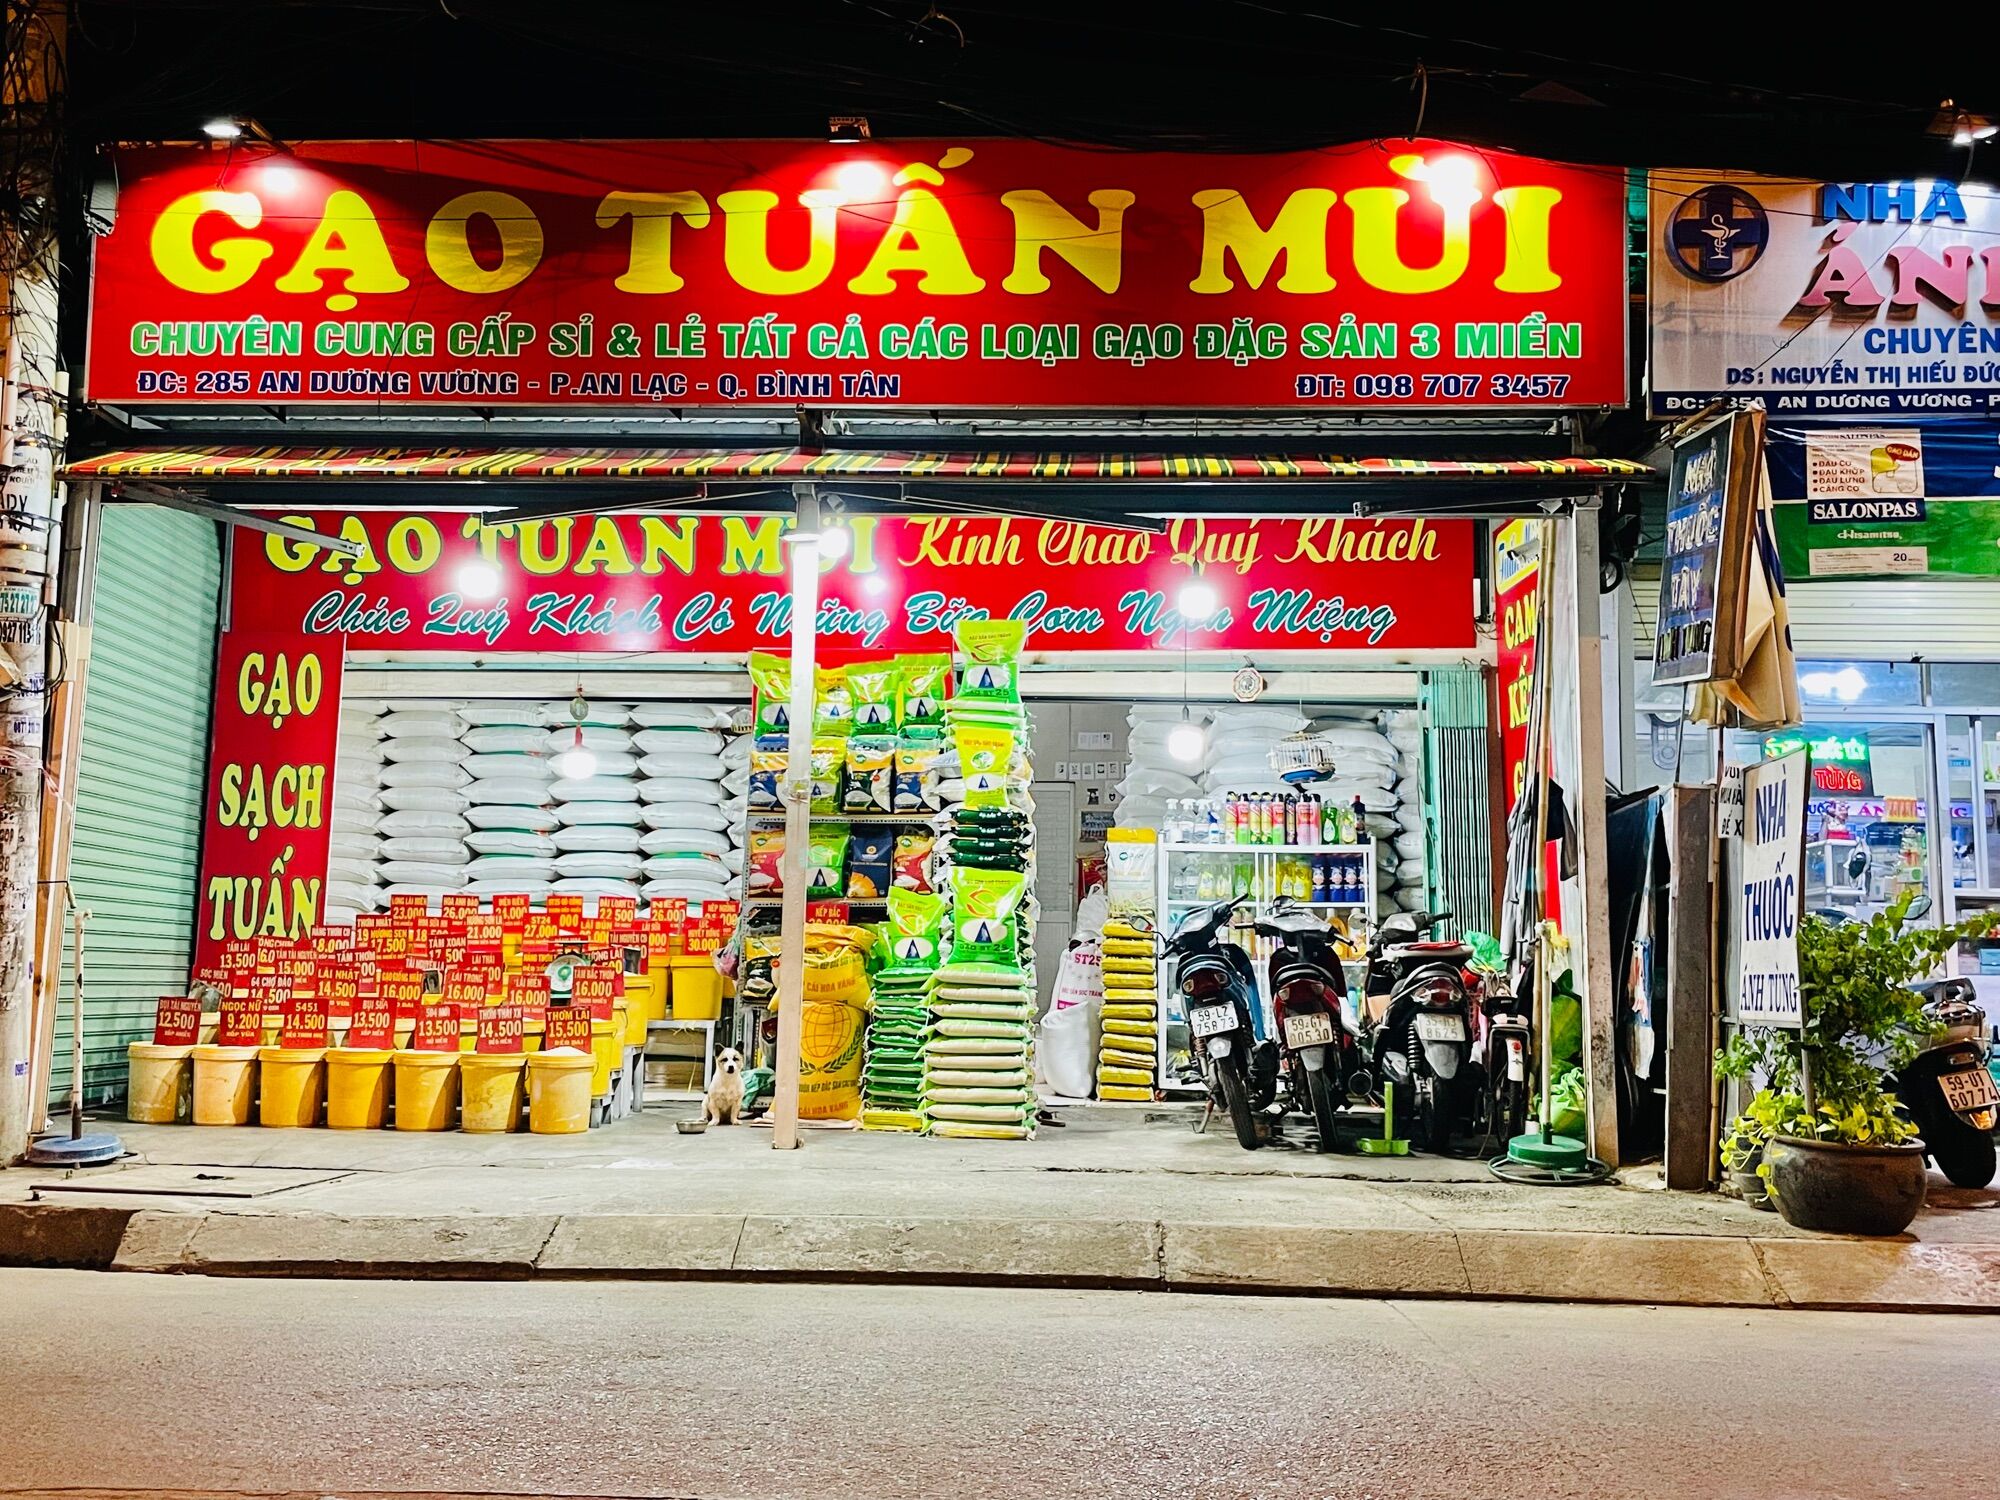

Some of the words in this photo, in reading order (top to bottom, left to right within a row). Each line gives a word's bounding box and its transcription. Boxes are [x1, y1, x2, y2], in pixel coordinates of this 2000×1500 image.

[150, 189, 545, 312] GẠO
[595, 146, 1137, 296] TUẤN
[1799, 222, 2000, 307] ÁN
[130, 315, 302, 359] CHUYÊN
[315, 322, 440, 359] CUNG
[448, 312, 535, 359] CẤP
[547, 313, 594, 359] SỈ
[607, 325, 644, 358] &
[654, 314, 706, 359] LẺ
[721, 312, 797, 359] TẤT
[808, 313, 870, 359] CẢ
[880, 316, 967, 359] CÁC
[981, 323, 1080, 367] LOẠI
[1095, 323, 1183, 367] GẠO
[1194, 319, 1287, 367] ĐẶC
[1301, 314, 1398, 359] SẢN
[1411, 323, 1439, 359] 3
[1456, 312, 1583, 359] MIỀN
[1771, 360, 1859, 385] NGUYỄN
[1865, 366, 1901, 388] THỊ
[1907, 360, 1956, 384] HIẾU
[136, 371, 188, 394] ĐC:
[195, 371, 250, 393] 285
[257, 371, 301, 394] AN
[309, 370, 411, 395] DƯƠNG
[419, 370, 519, 395] VƯƠNG
[548, 372, 620, 395] P.AN
[631, 372, 689, 400] LẠC
[718, 373, 747, 397] Q.
[756, 366, 831, 397] BÌNH
[838, 366, 901, 398] TÂN
[1295, 375, 1346, 398] ĐT:
[1352, 375, 1415, 398] 098
[1421, 375, 1483, 398] 707
[1490, 375, 1571, 398] 3457
[1666, 397, 1705, 410] ĐC:
[1777, 396, 1807, 409] AN
[1815, 394, 1891, 408] DƯƠNG
[1897, 393, 1972, 408] VƯƠNG
[1814, 502, 1918, 520] SALONPAS
[265, 515, 441, 586] GẠO
[897, 516, 1024, 566] Kính
[1170, 519, 1263, 575] Quý
[1274, 517, 1441, 563] Khách
[1894, 553, 1907, 561] 20
[303, 590, 411, 635] Chúc
[423, 592, 510, 645] Quý
[526, 591, 662, 636] Khách
[673, 592, 735, 641] Có
[749, 592, 890, 648] Nững
[1248, 588, 1397, 643] Miệng
[237, 652, 323, 730] GẠO
[218, 763, 326, 842] SẠCH
[1756, 764, 1787, 845] NHÀ
[208, 844, 321, 942] TUẤN
[1744, 851, 1794, 942] THUỐC
[652, 899, 686, 908] NẾP
[531, 916, 551, 924] ST24
[467, 926, 502, 939] 21.000
[524, 925, 558, 938] 27.000
[220, 953, 256, 968] 13.500
[278, 961, 314, 975] 15.000
[1074, 953, 1102, 967] ST25
[318, 981, 356, 998] 14.500
[383, 984, 420, 1000] 16.000
[447, 984, 484, 1000] 16.000
[575, 981, 612, 997] 16.000
[1740, 962, 1764, 1011] ÁNH
[1768, 962, 1798, 1014] TÙNG
[222, 1001, 246, 1013] NGỌC
[295, 1002, 318, 1012] 5451
[510, 991, 546, 1006] 16.000
[159, 1012, 195, 1030] 12.500
[227, 1013, 260, 1029] 9.200
[286, 1014, 326, 1030] 14.500
[353, 1012, 390, 1028] 13.500
[547, 1010, 573, 1020] THƠM
[418, 1020, 457, 1036] 13.500
[479, 1020, 522, 1038] 14.500
[549, 1021, 588, 1038] 15.500
[1946, 1071, 1984, 1091] 59-U1
